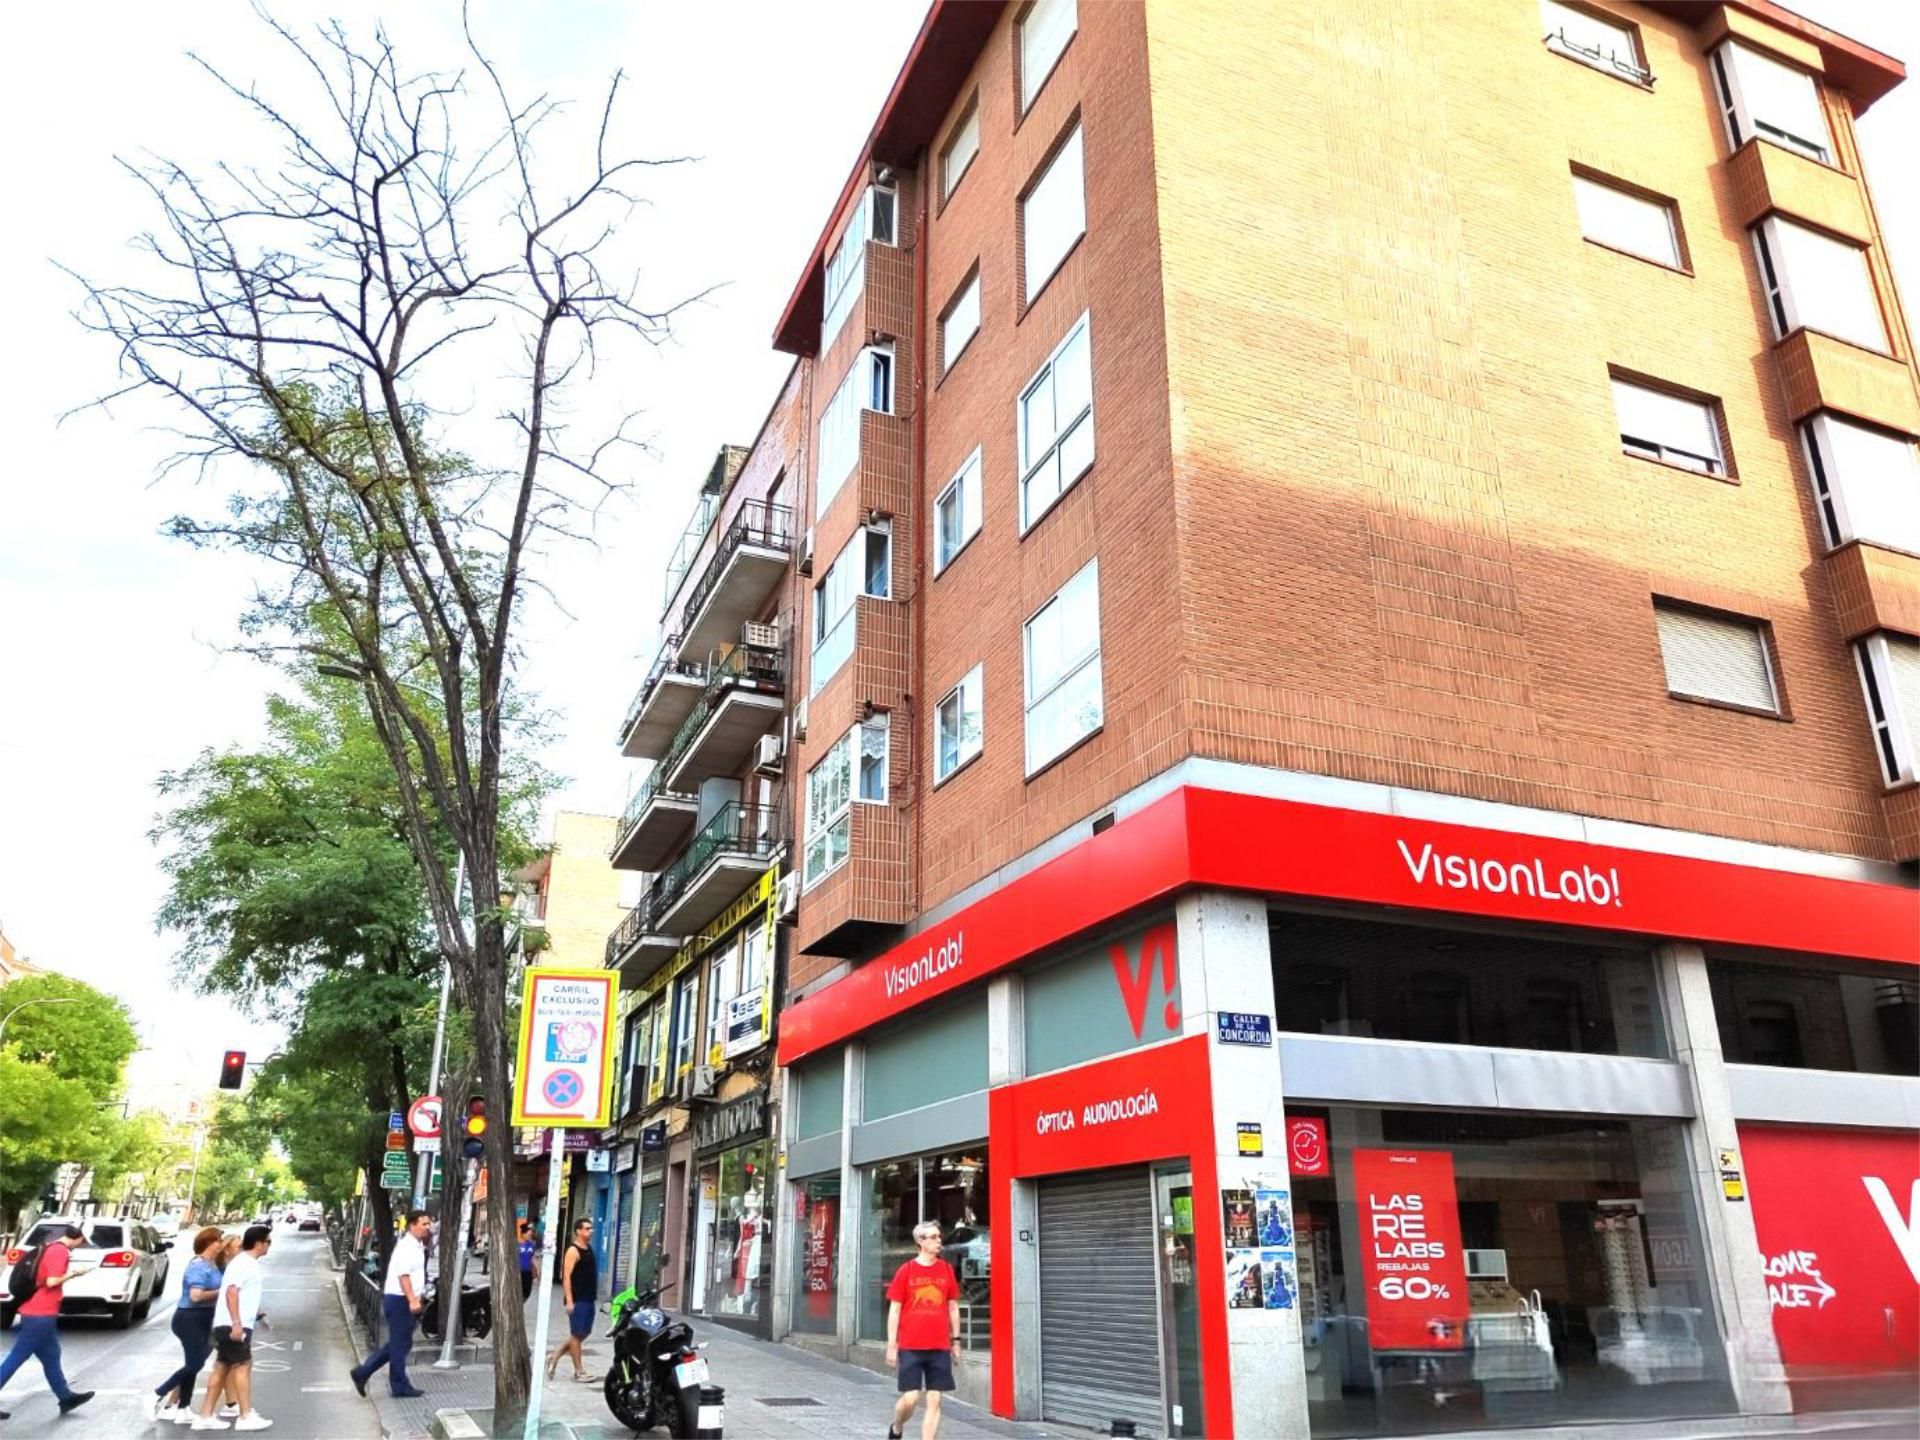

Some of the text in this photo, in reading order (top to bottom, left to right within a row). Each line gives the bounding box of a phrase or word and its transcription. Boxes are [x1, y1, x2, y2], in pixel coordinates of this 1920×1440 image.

[1397, 839, 1622, 907] VisionLab!
[884, 930, 963, 999] VisionLab!
[553, 984, 591, 994] CARRIL
[542, 995, 600, 1006] EXCLUSIVO
[1233, 1014, 1261, 1025] CALLE
[1219, 1028, 1271, 1043] CONCORDIA
[1037, 1087, 1159, 1135] ÓPTICA AUDIOLOGÍA
[1370, 1194, 1423, 1210] LAS
[1372, 1214, 1426, 1239] RE
[1375, 1242, 1445, 1259] LABS
[1377, 1263, 1430, 1271] REBAJAS
[1769, 1282, 1811, 1308] ALE
